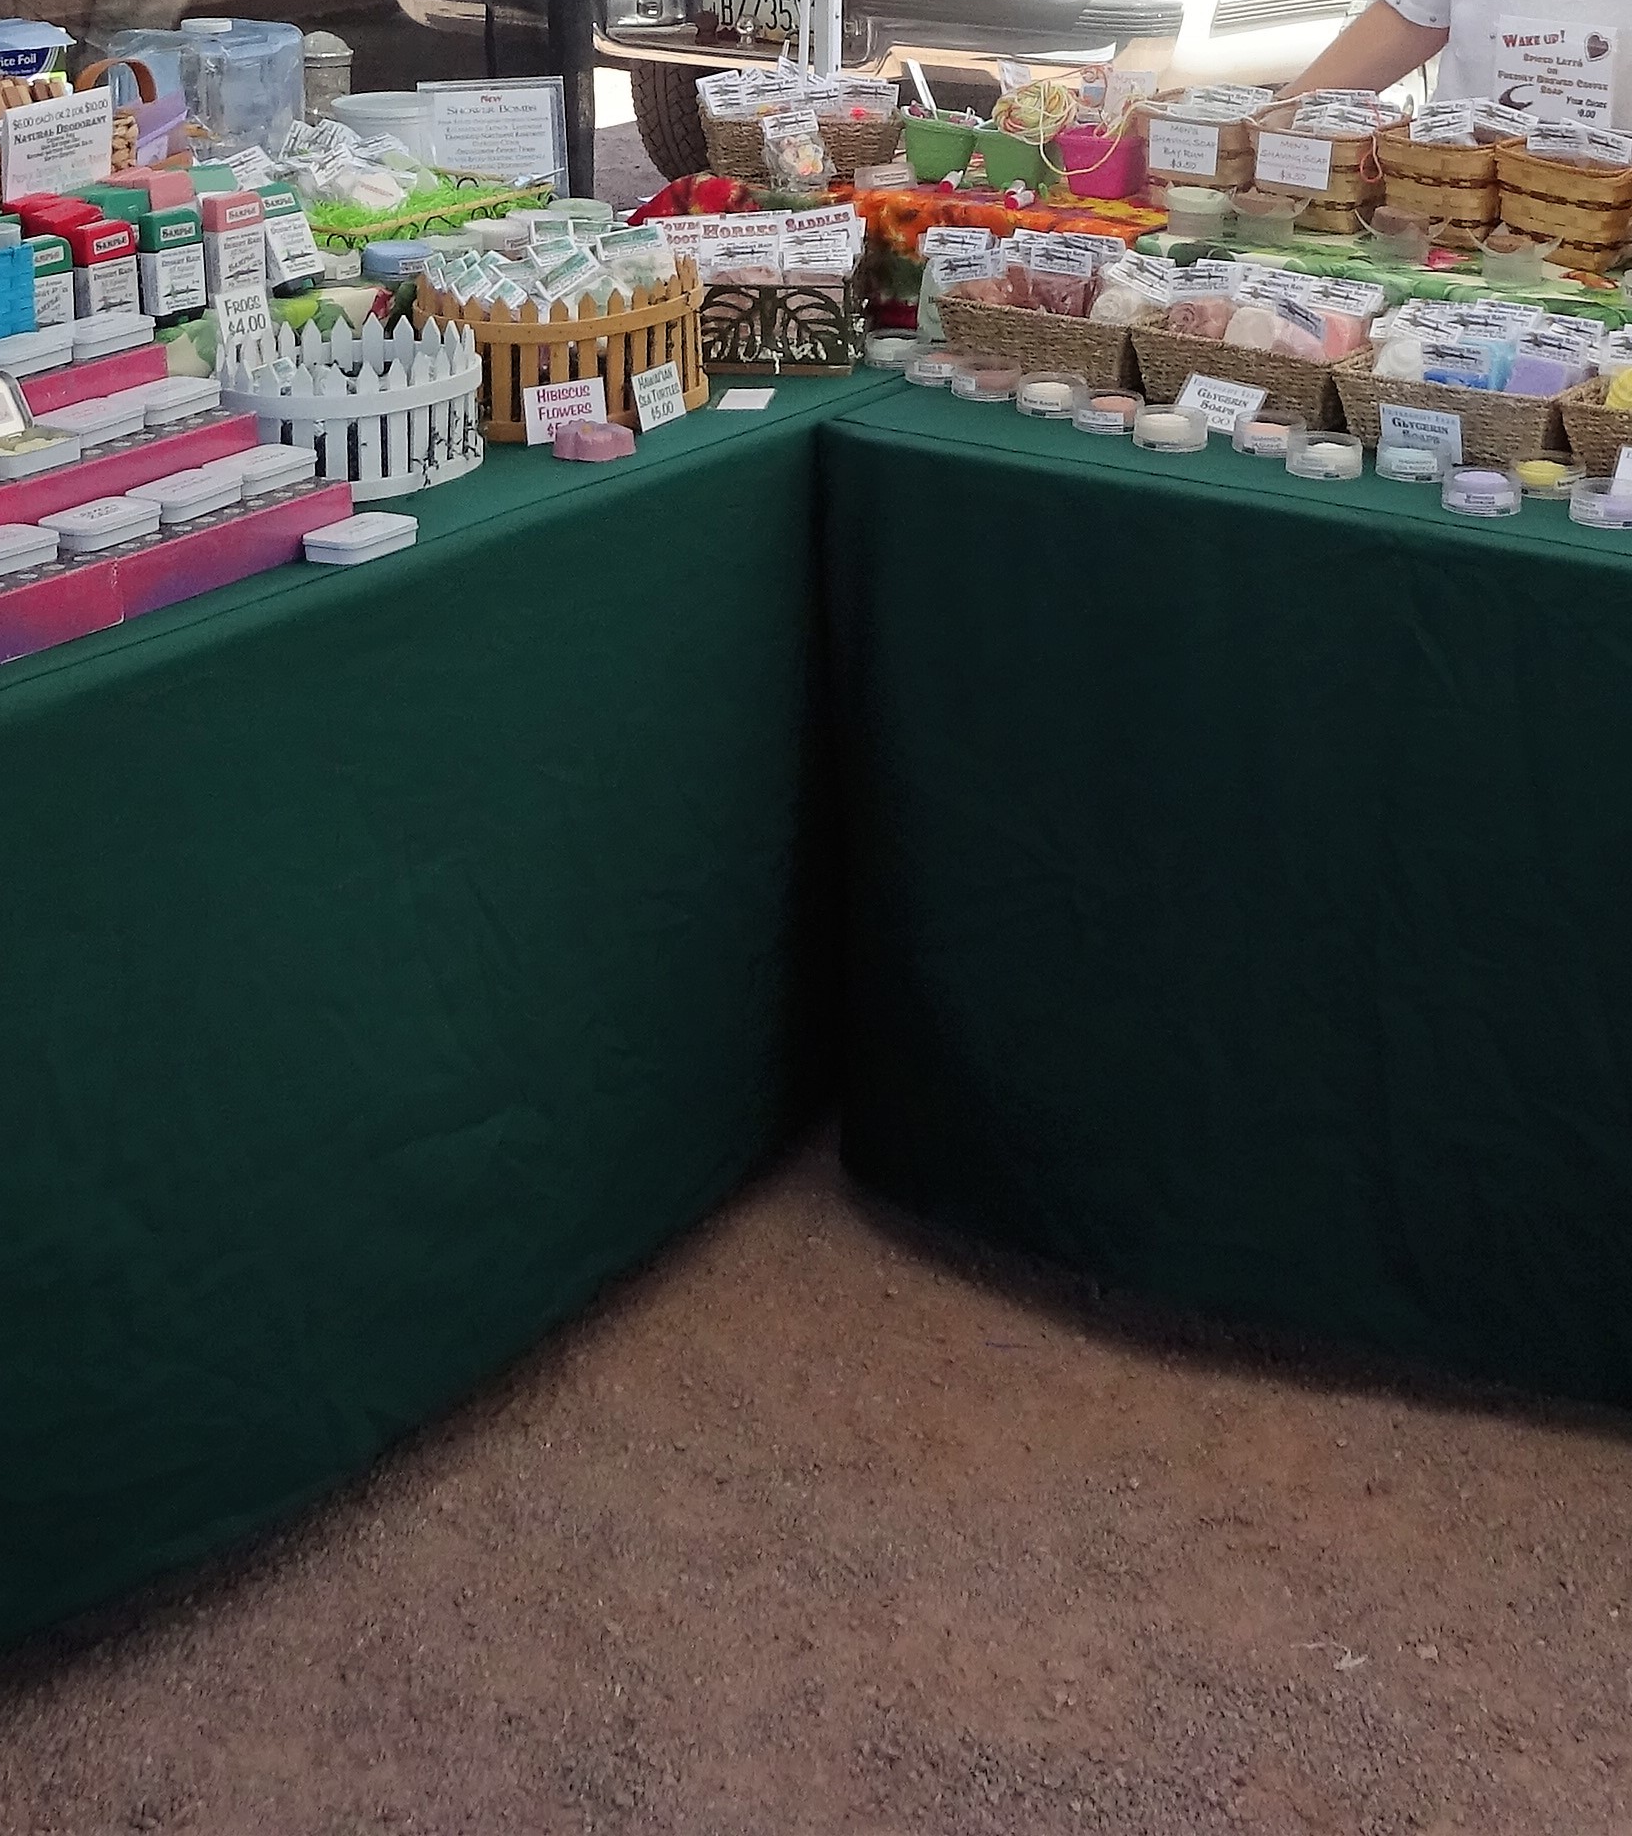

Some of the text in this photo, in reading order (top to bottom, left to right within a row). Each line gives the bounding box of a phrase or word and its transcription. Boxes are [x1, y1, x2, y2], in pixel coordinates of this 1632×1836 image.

[17, 53, 37, 65] Foil
[162, 225, 194, 239] SAMPLE
[702, 222, 779, 240] HORSES
[785, 211, 850, 233] SADDLES
[95, 235, 128, 251] SAMPLE
[35, 250, 61, 263] AMPLE
[224, 295, 262, 318] FROGS
[228, 313, 267, 338] $4.00
[637, 365, 674, 391] HAWAIIAN
[536, 384, 591, 404] HIBISCUS
[637, 382, 681, 409] SEA TURTLES
[1197, 387, 1249, 408] GLYCERIN
[537, 402, 593, 422] FLOWERS
[650, 400, 675, 422] $5.00
[1200, 399, 1235, 415] SOAPS
[1392, 416, 1449, 436] GLYCERIN
